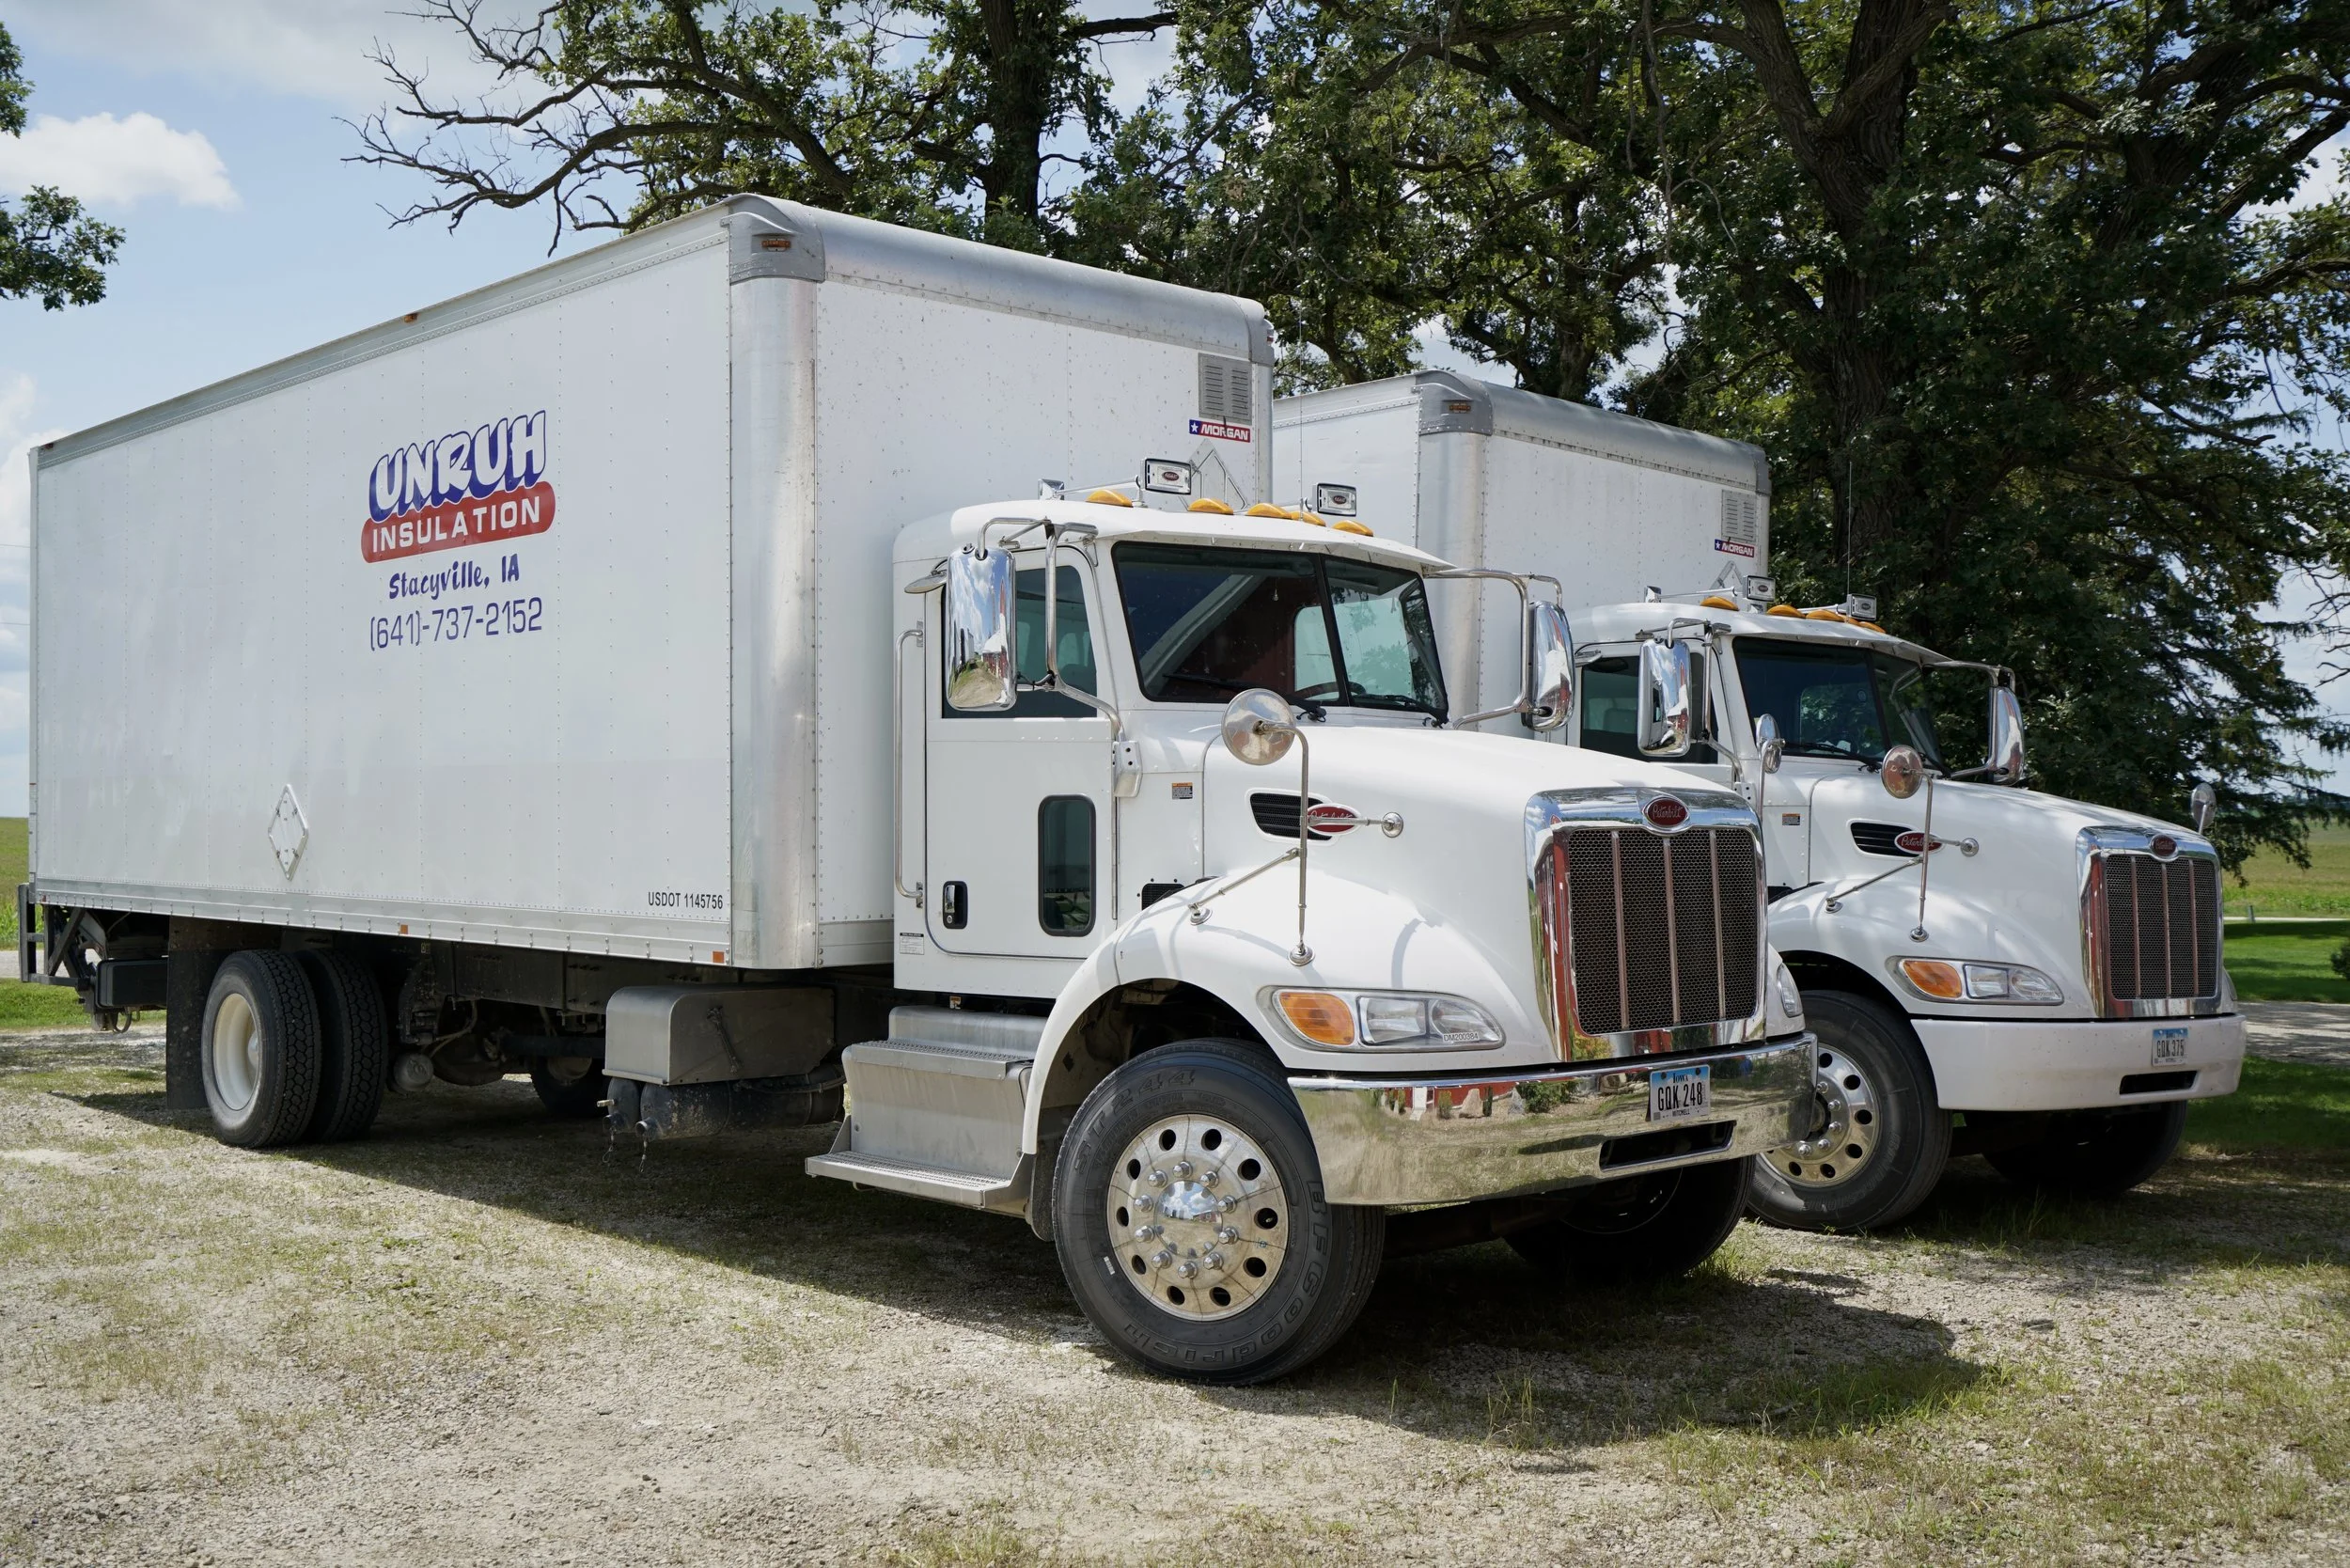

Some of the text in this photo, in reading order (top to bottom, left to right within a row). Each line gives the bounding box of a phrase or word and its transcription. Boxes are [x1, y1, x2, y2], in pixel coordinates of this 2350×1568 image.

[1200, 423, 1249, 440] MORGAN
[368, 410, 546, 524] UNRUH
[372, 496, 540, 553] INSULATION
[1721, 542, 1754, 557] MORGAN
[388, 553, 520, 601] Stacyville, IA
[369, 596, 543, 651] (641)-737-2152
[1652, 804, 1684, 820] Peterbilt
[648, 891, 724, 910] USDOT 1145756
[2171, 1040, 2185, 1057] 375
[1657, 1085, 1680, 1111] GQK
[1683, 1082, 1702, 1107] 248
